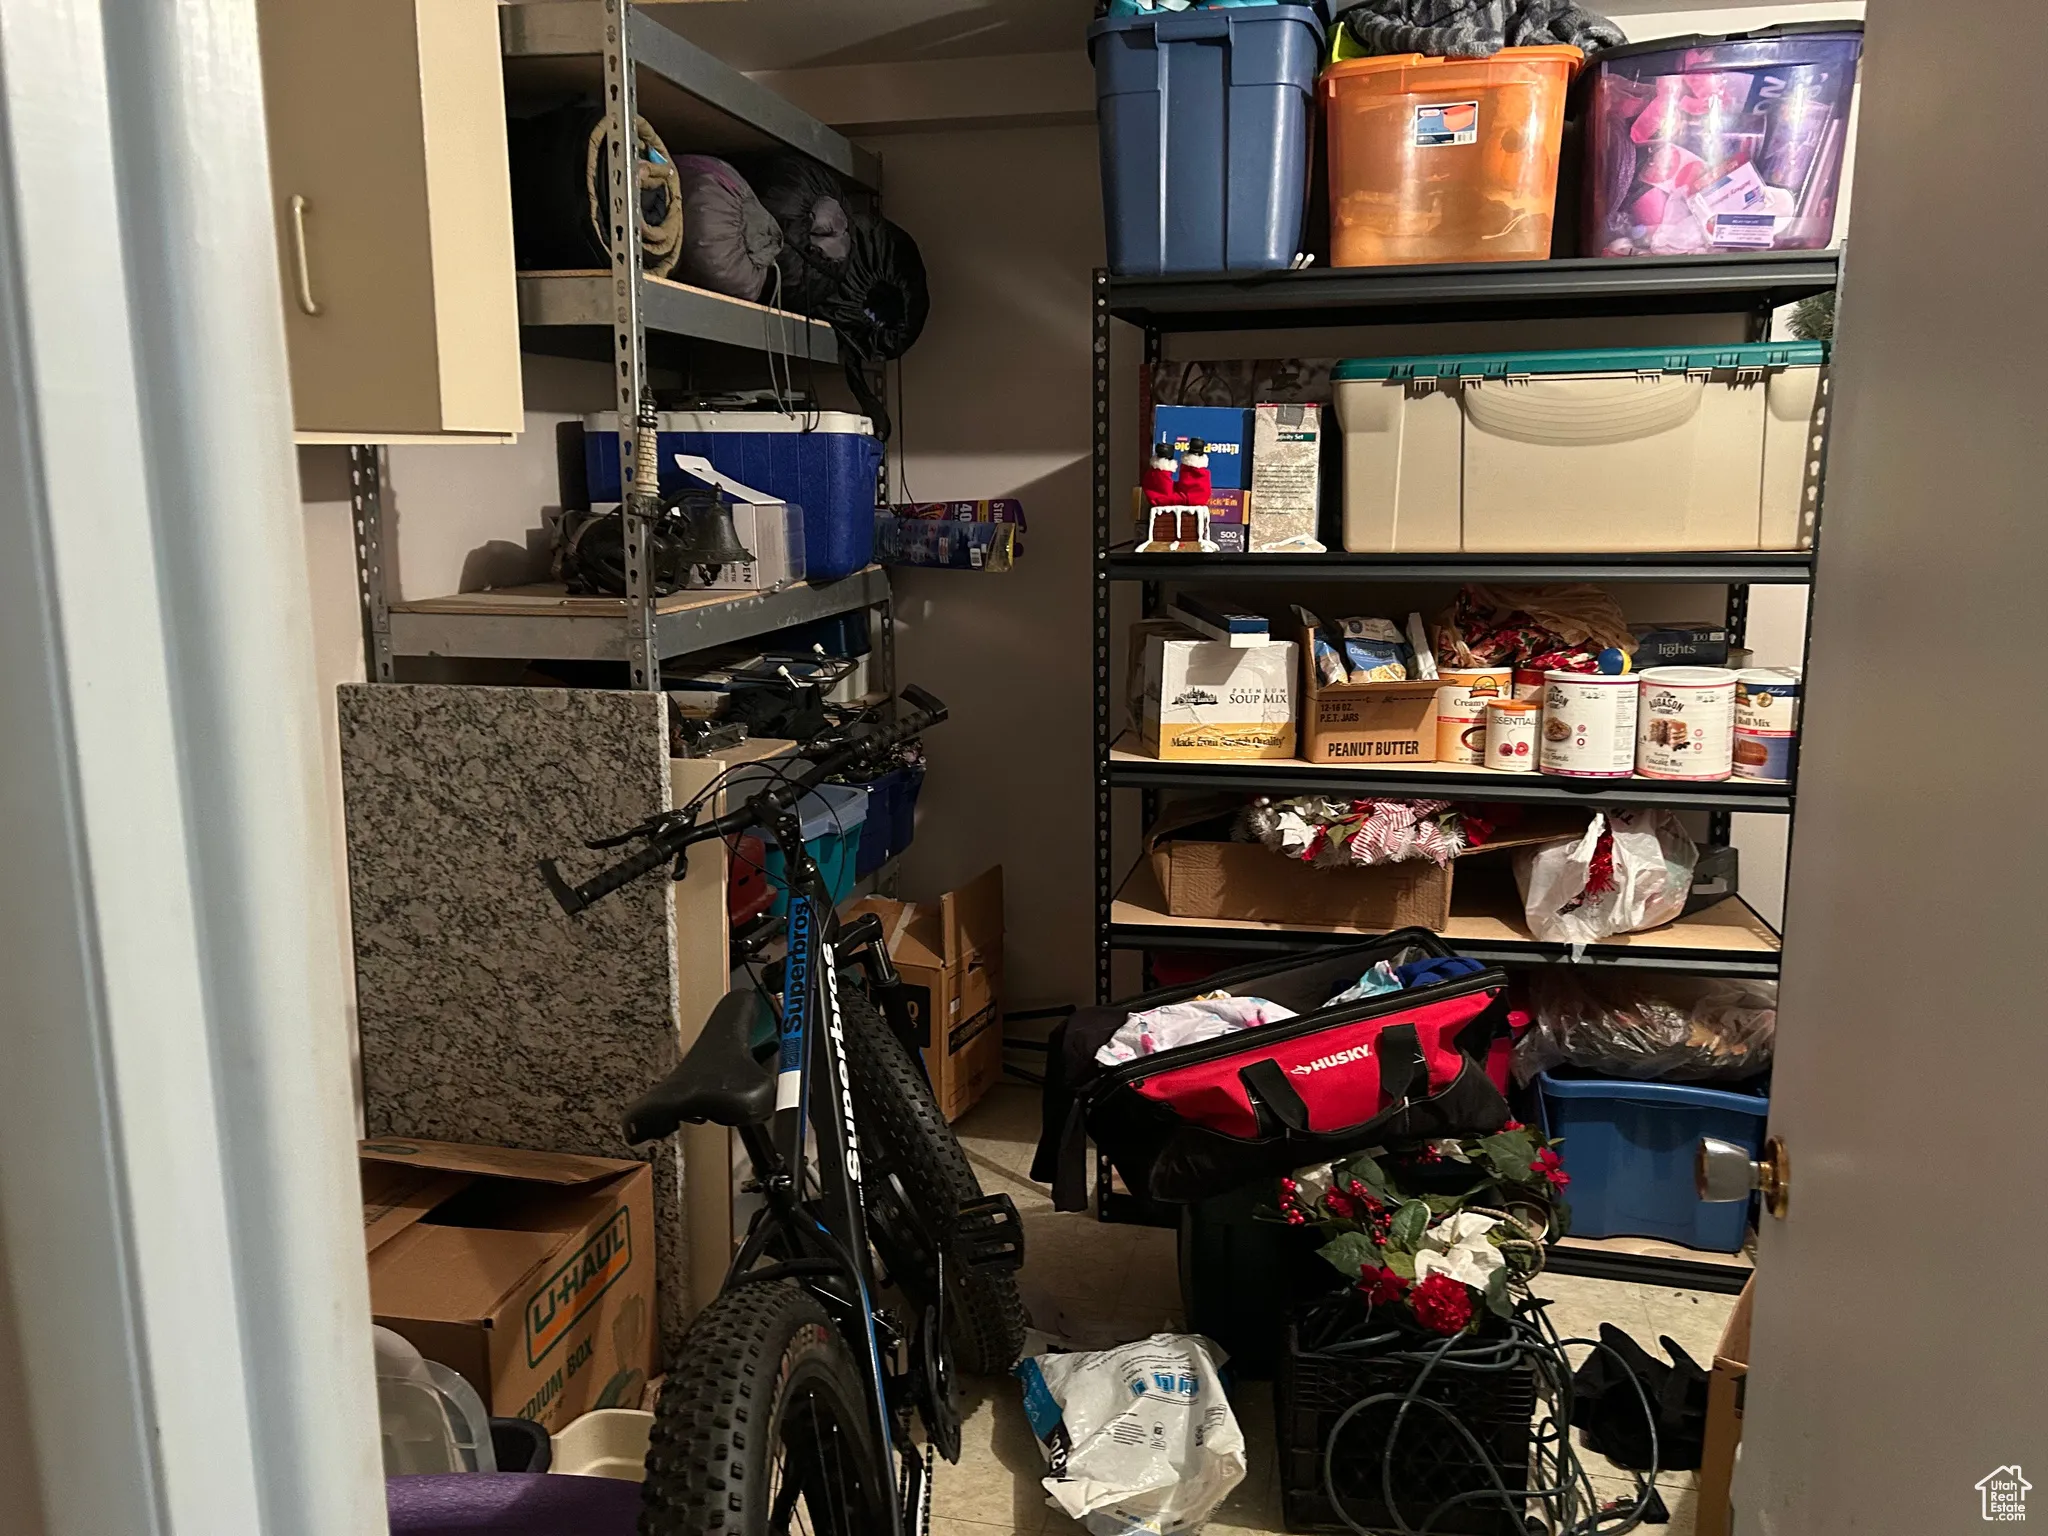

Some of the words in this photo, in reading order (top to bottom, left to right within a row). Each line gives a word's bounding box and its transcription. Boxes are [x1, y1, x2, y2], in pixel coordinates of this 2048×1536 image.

[1220, 531, 1237, 539] 500
[1692, 632, 1708, 642] 100
[1658, 643, 1697, 658] lights
[1229, 693, 1259, 704] SOUP
[1262, 693, 1288, 704] MIX
[1340, 713, 1360, 722] JARS
[1752, 718, 1771, 728] Mix
[1171, 736, 1195, 747] Made
[1328, 742, 1374, 757] PEANUT
[1376, 741, 1419, 756] BUTTER
[783, 899, 810, 1036] Superbros
[822, 942, 863, 1182] Superbros
[1310, 1043, 1370, 1072] HUSKY
[533, 1221, 625, 1335] U-HAUL
[566, 1333, 594, 1379] BOX
